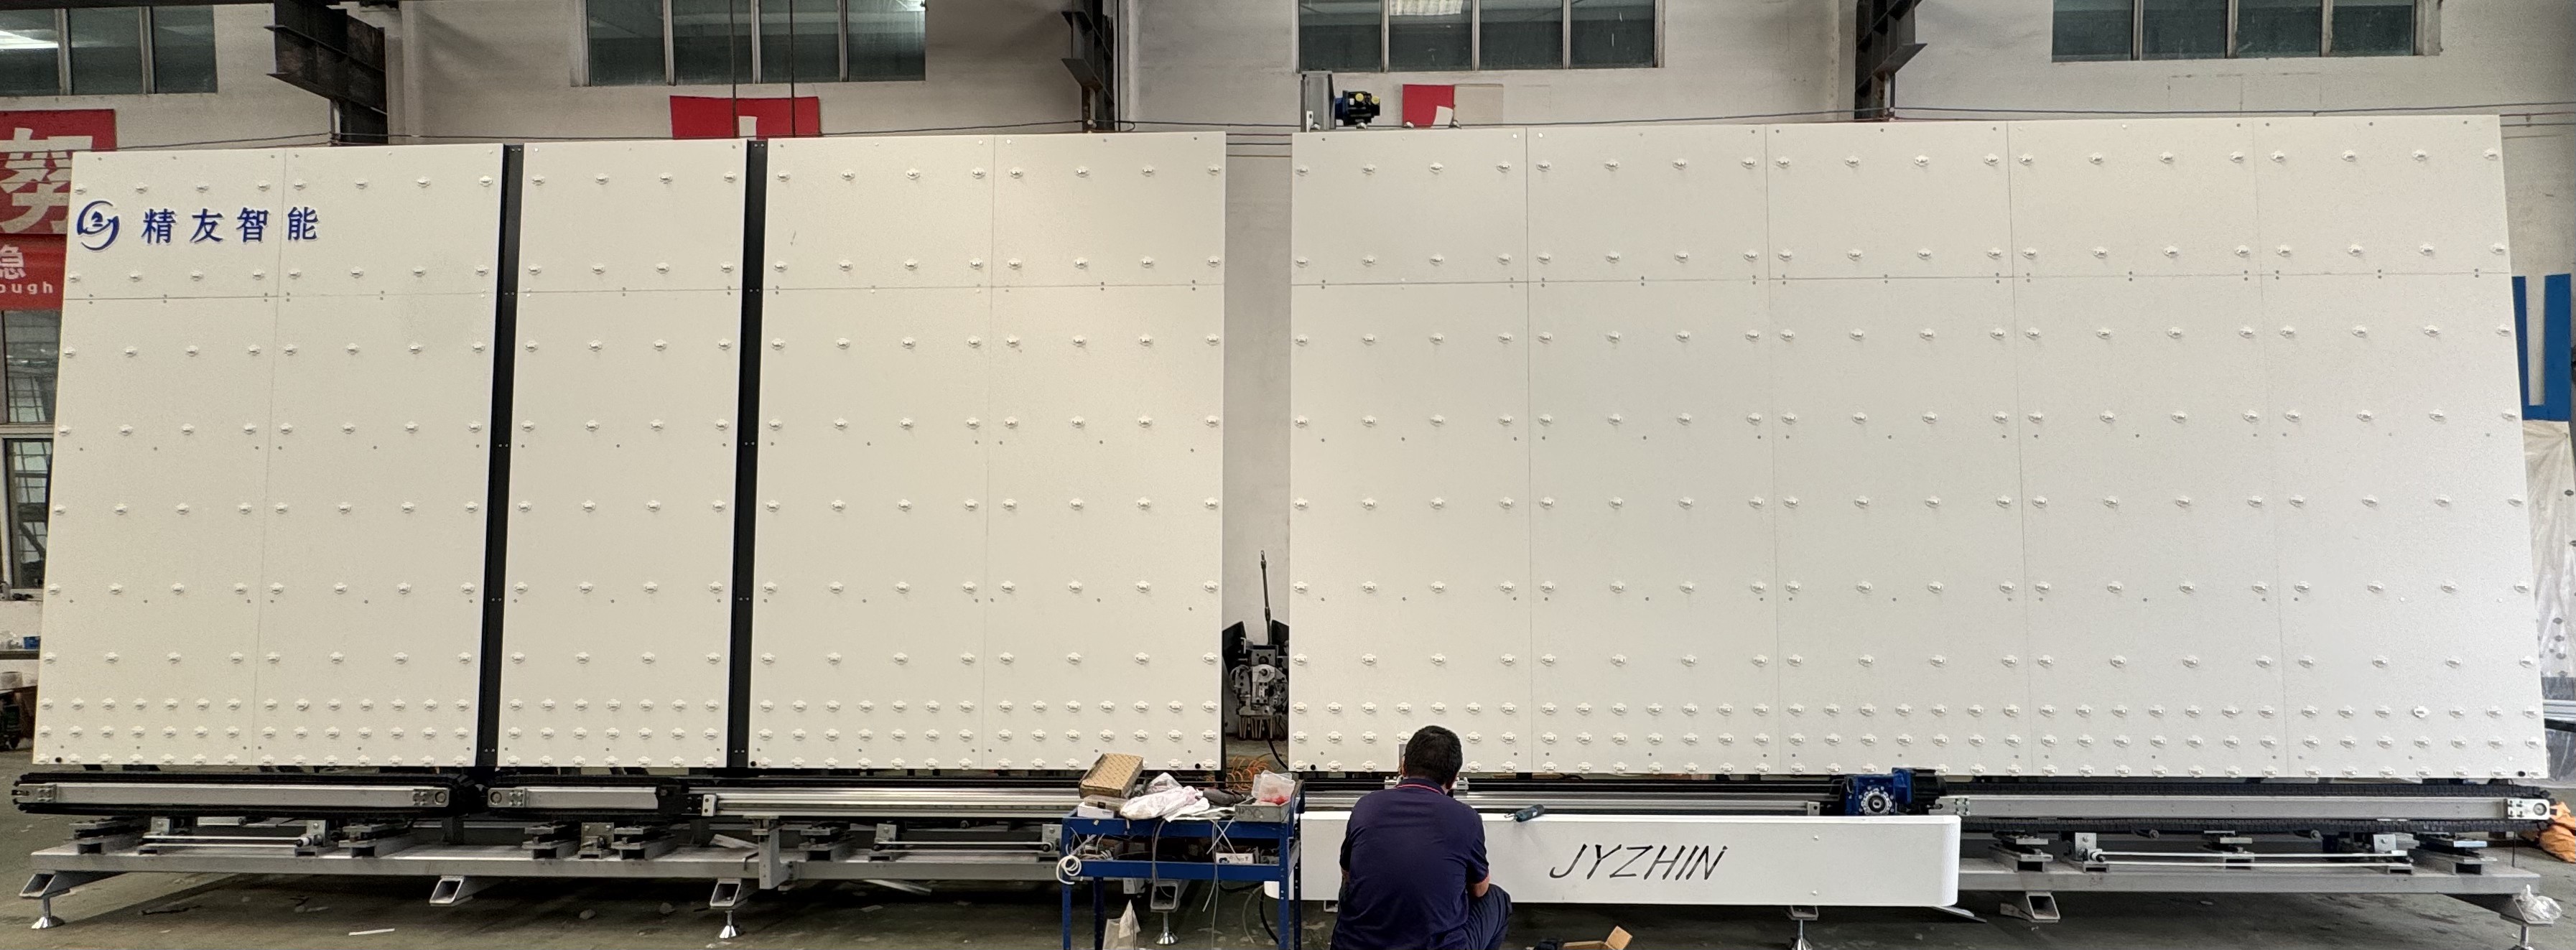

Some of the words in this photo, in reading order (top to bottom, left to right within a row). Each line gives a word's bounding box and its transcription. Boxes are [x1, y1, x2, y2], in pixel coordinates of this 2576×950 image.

[141, 206, 319, 244] 精友智能
[1548, 843, 1728, 881] JYZHIN
